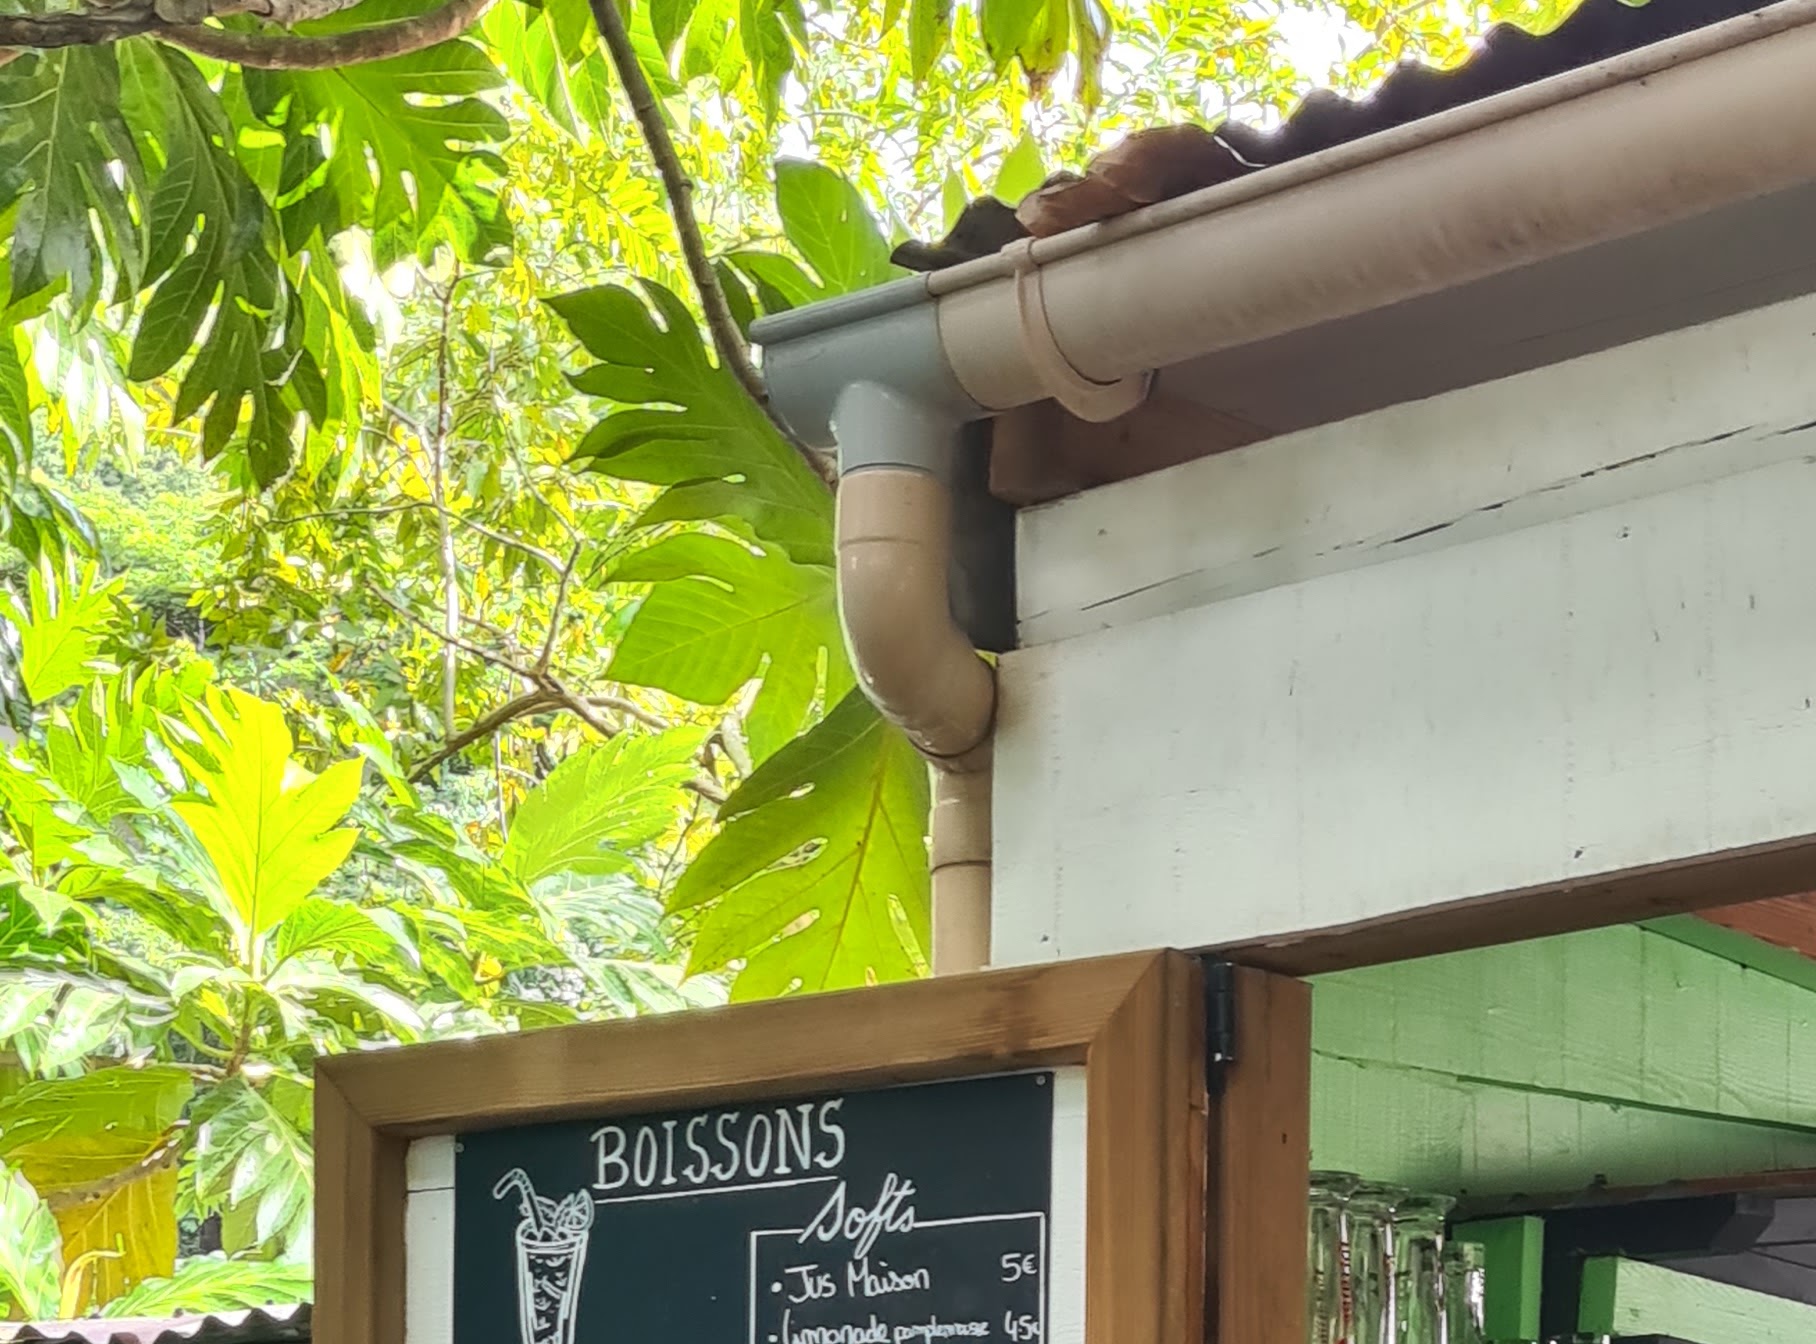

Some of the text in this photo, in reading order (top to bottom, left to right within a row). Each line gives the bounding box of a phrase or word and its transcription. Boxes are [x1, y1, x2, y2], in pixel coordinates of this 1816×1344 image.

[590, 1098, 847, 1190] BOISSONS
[798, 1173, 916, 1260] Softs
[784, 1253, 1038, 1303] Jus Maison 5€
